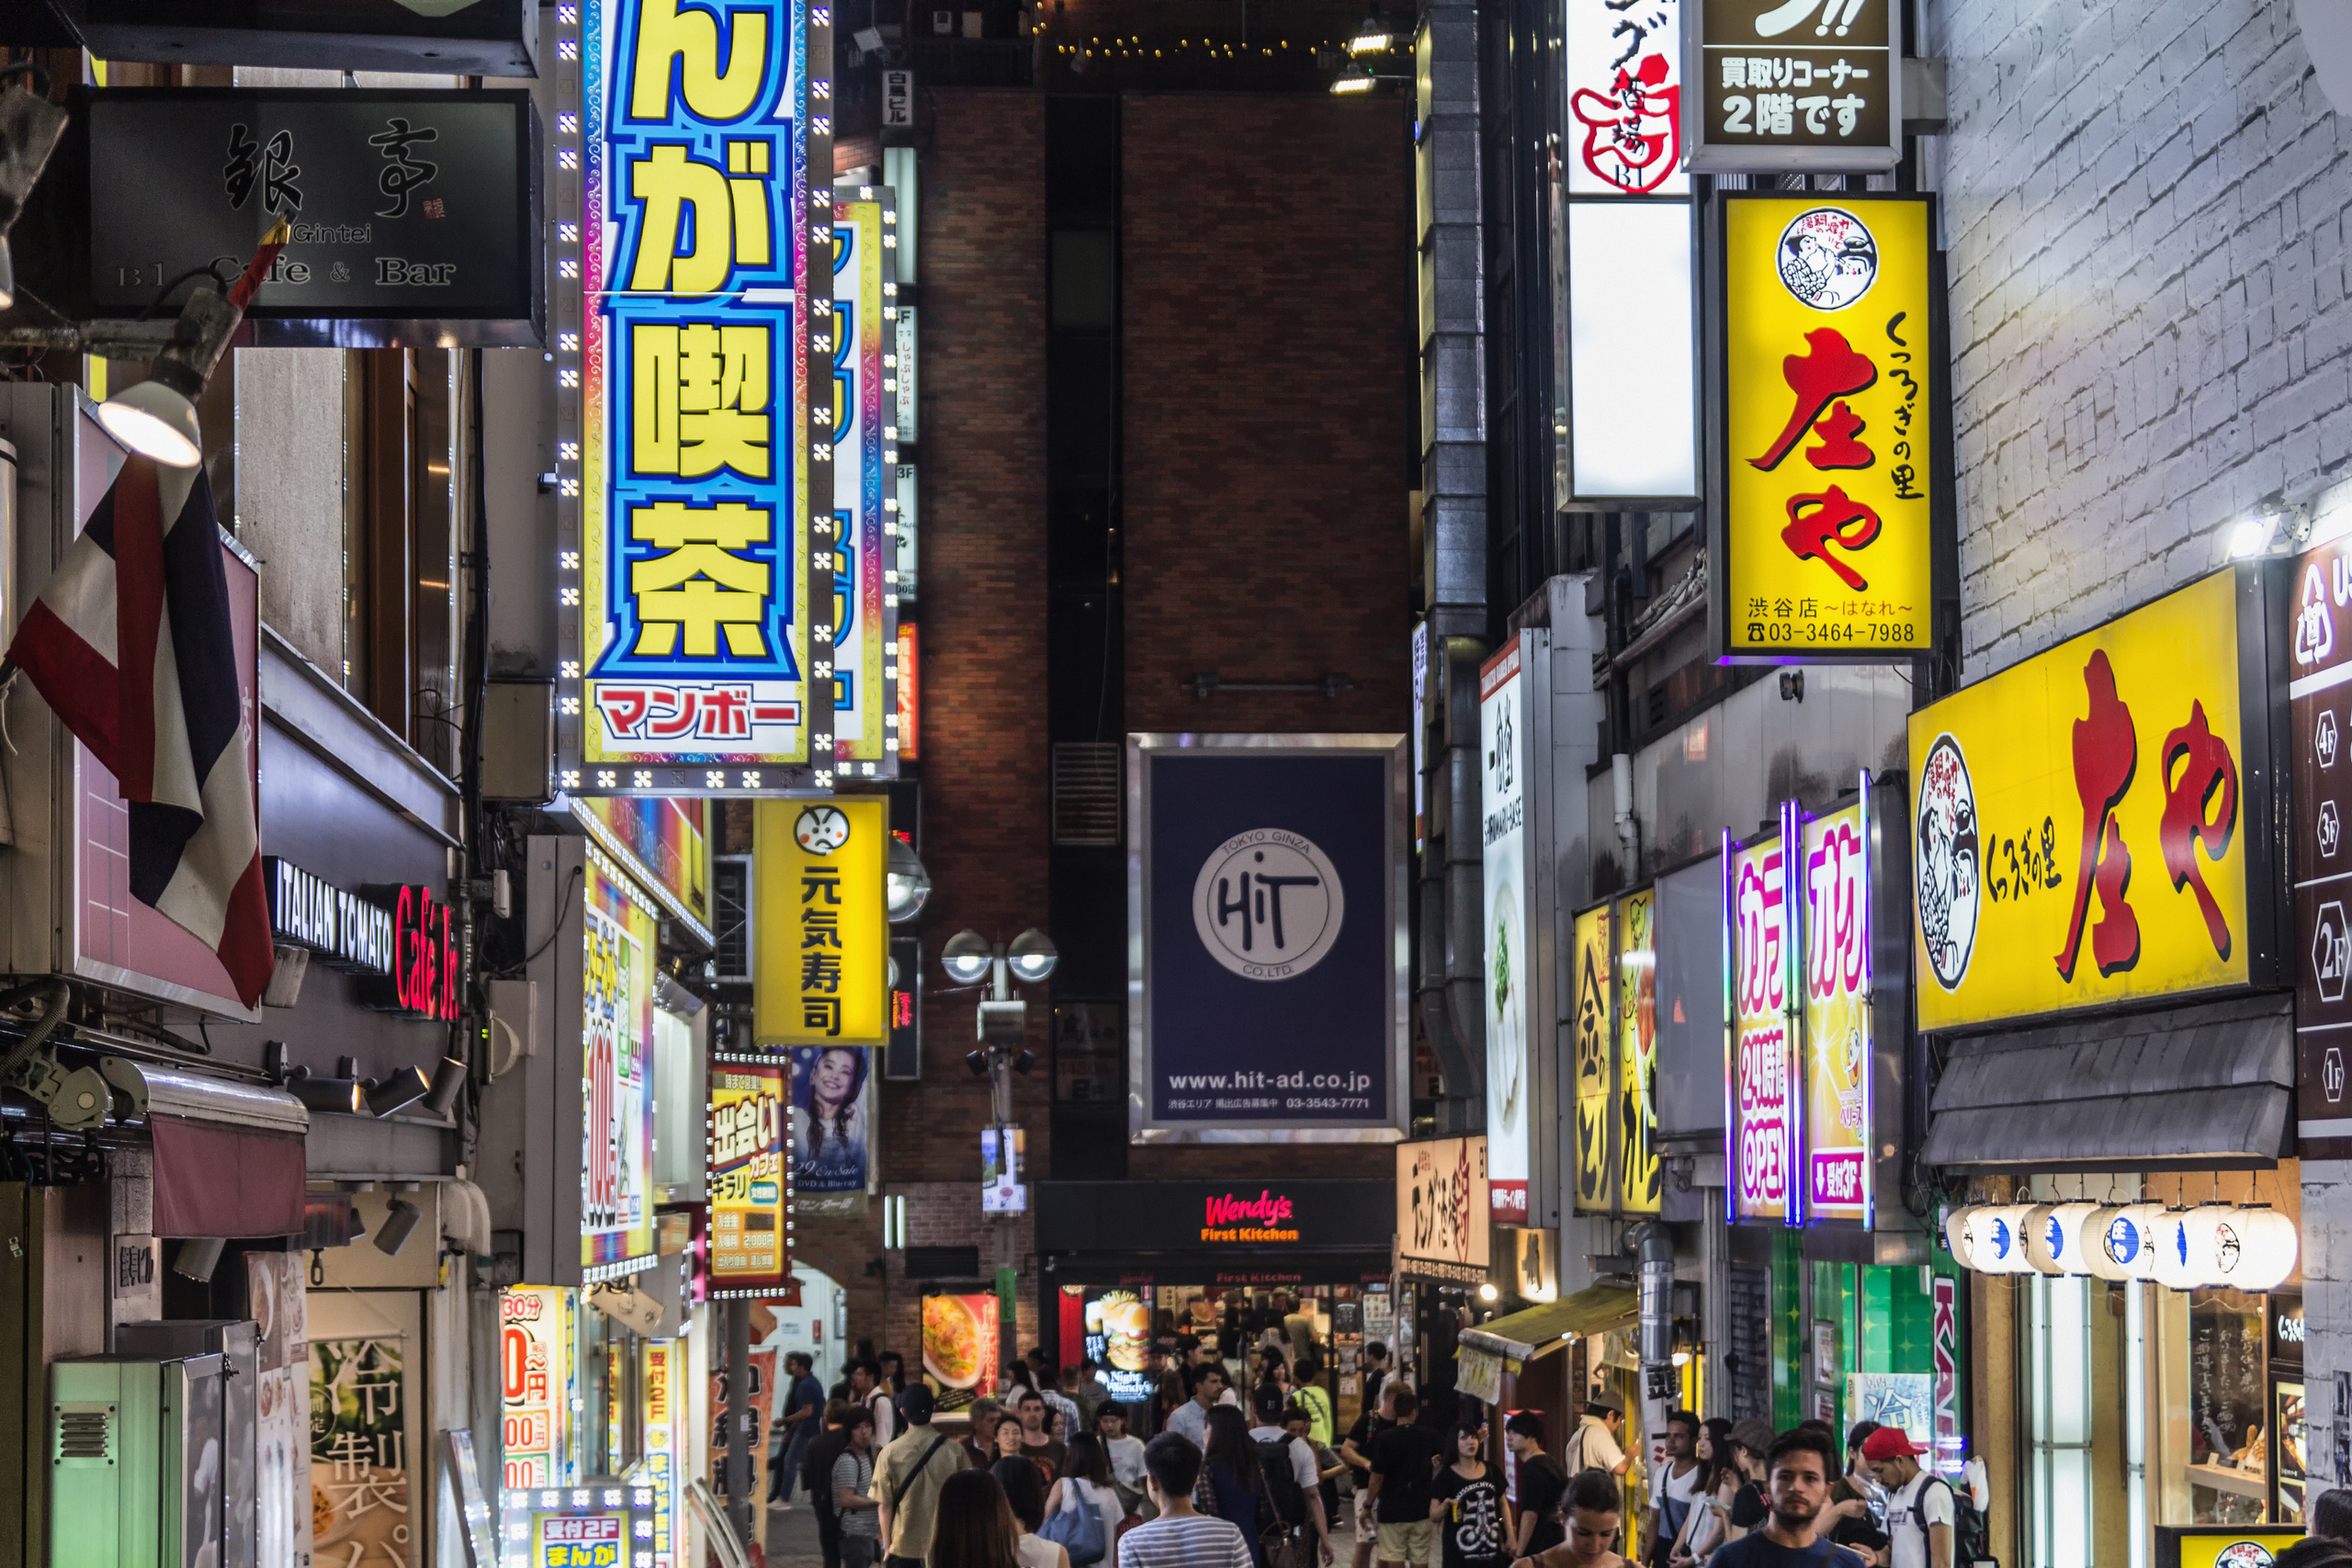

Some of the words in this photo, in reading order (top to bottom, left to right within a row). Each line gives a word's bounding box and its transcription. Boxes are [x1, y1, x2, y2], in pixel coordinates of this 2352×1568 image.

[1722, 57, 1869, 89] 買取りコーナー
[1723, 93, 1866, 136] 2階です
[1614, 164, 1643, 186] B1
[292, 223, 371, 243] Gintei
[330, 262, 350, 281] &
[376, 257, 457, 286] Bar
[1886, 310, 1924, 500] くつろぎの里
[1745, 327, 1882, 592] 庄や
[1747, 598, 1818, 618] 渋谷店
[1770, 623, 1915, 642] 03-3464-7988
[598, 688, 797, 737] マンボー
[2319, 721, 2335, 755] 4F
[2054, 649, 2238, 984] 庄や
[2322, 812, 2335, 847] 3F
[1221, 830, 1265, 856] TOKYO
[1271, 830, 1312, 856] GINZA
[1986, 816, 2062, 903] くつろぎの里
[277, 858, 335, 953] ITALIAN
[338, 887, 393, 975] TOMATO
[800, 865, 842, 1036] 元気寿司
[2320, 922, 2346, 979] 2F
[1169, 1070, 1371, 1092] www.hit-ad.co.jp
[2327, 1058, 2342, 1091] 1F
[1286, 1098, 1370, 1109] 03-3543-7771
[713, 1094, 777, 1167] 出会い
[749, 1152, 778, 1181] カフェ
[713, 1172, 747, 1201] キラリ
[797, 1179, 816, 1189] DVD
[828, 1179, 857, 1189] Blu-ray
[1205, 1190, 1294, 1226] Wendy's
[743, 1234, 775, 1249] 2,000円
[1201, 1228, 1237, 1241] First
[1239, 1227, 1299, 1242] Kitchen
[545, 1521, 618, 1540] 受付2F
[547, 1544, 616, 1568] まんが
